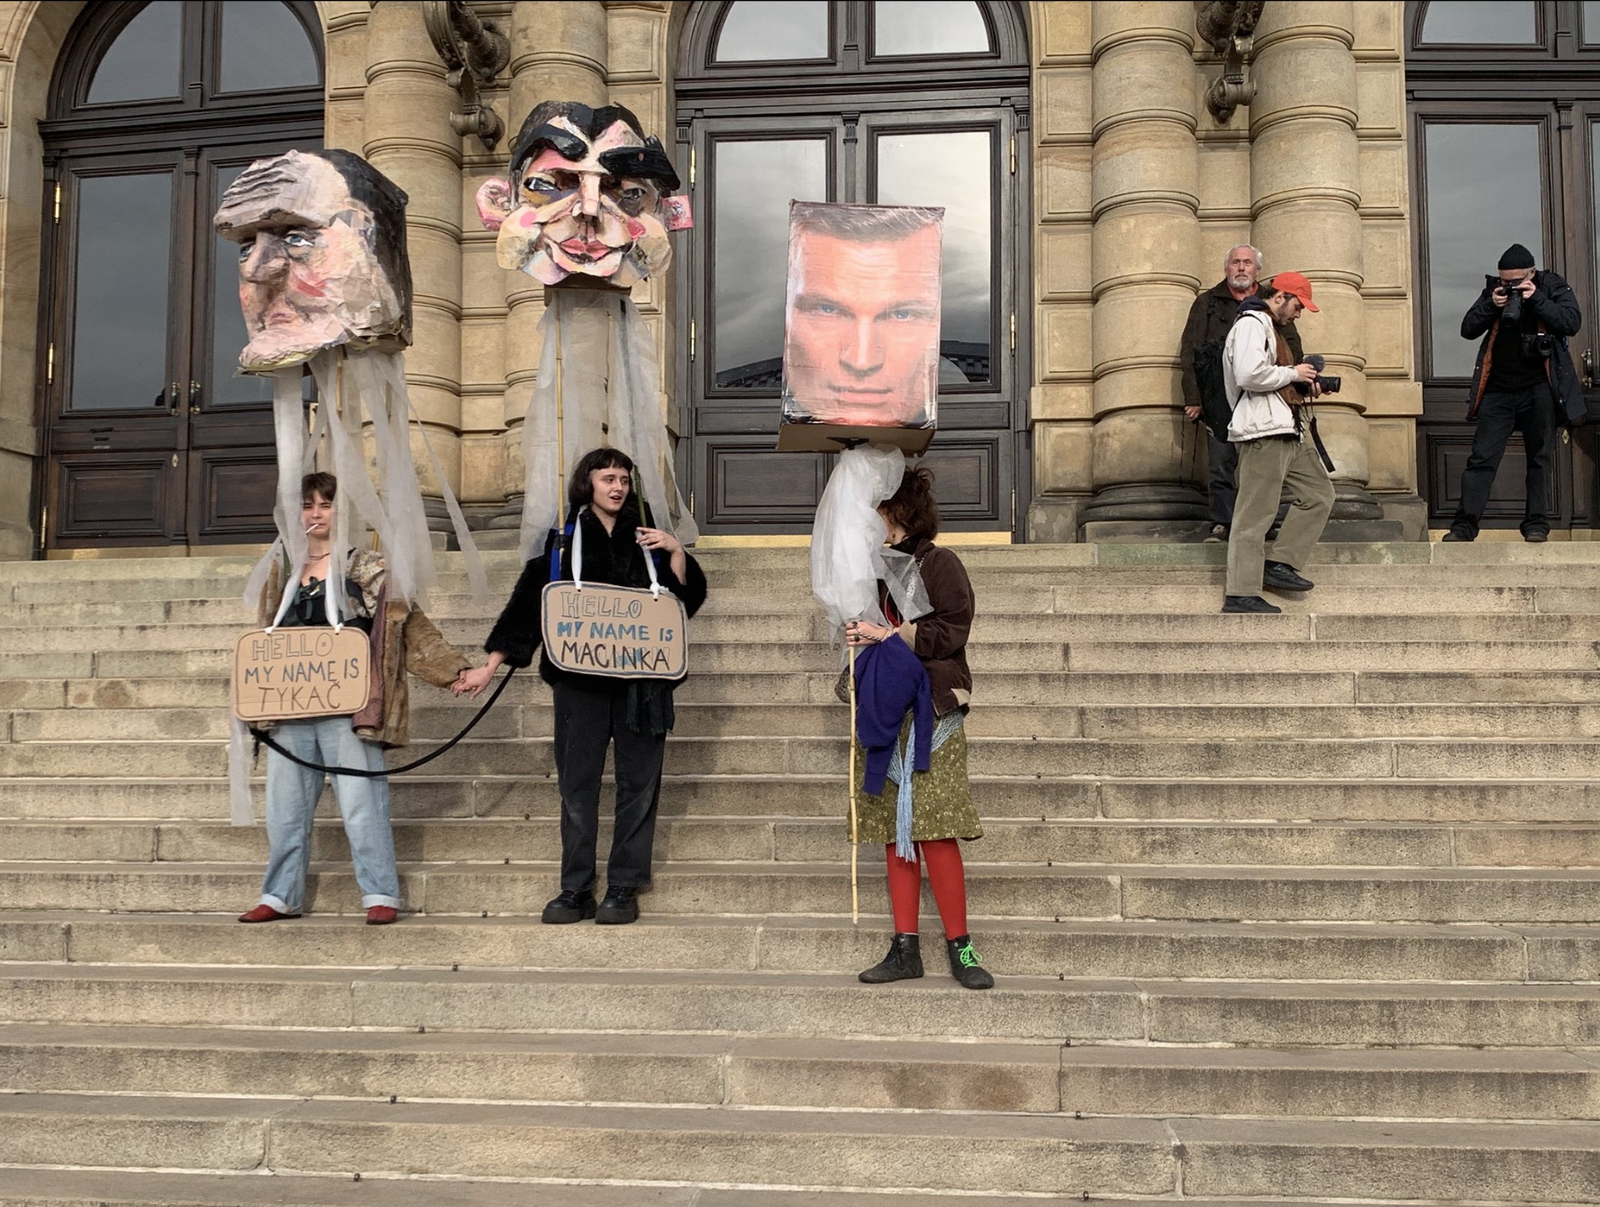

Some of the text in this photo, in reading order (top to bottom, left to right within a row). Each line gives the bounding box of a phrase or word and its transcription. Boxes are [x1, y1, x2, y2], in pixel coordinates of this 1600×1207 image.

[561, 591, 642, 619] HELLO
[557, 621, 674, 642] MY NAME IS
[252, 632, 334, 662] HELLO
[245, 658, 360, 684] MY NAME IS
[258, 681, 341, 712] TYKAČ
